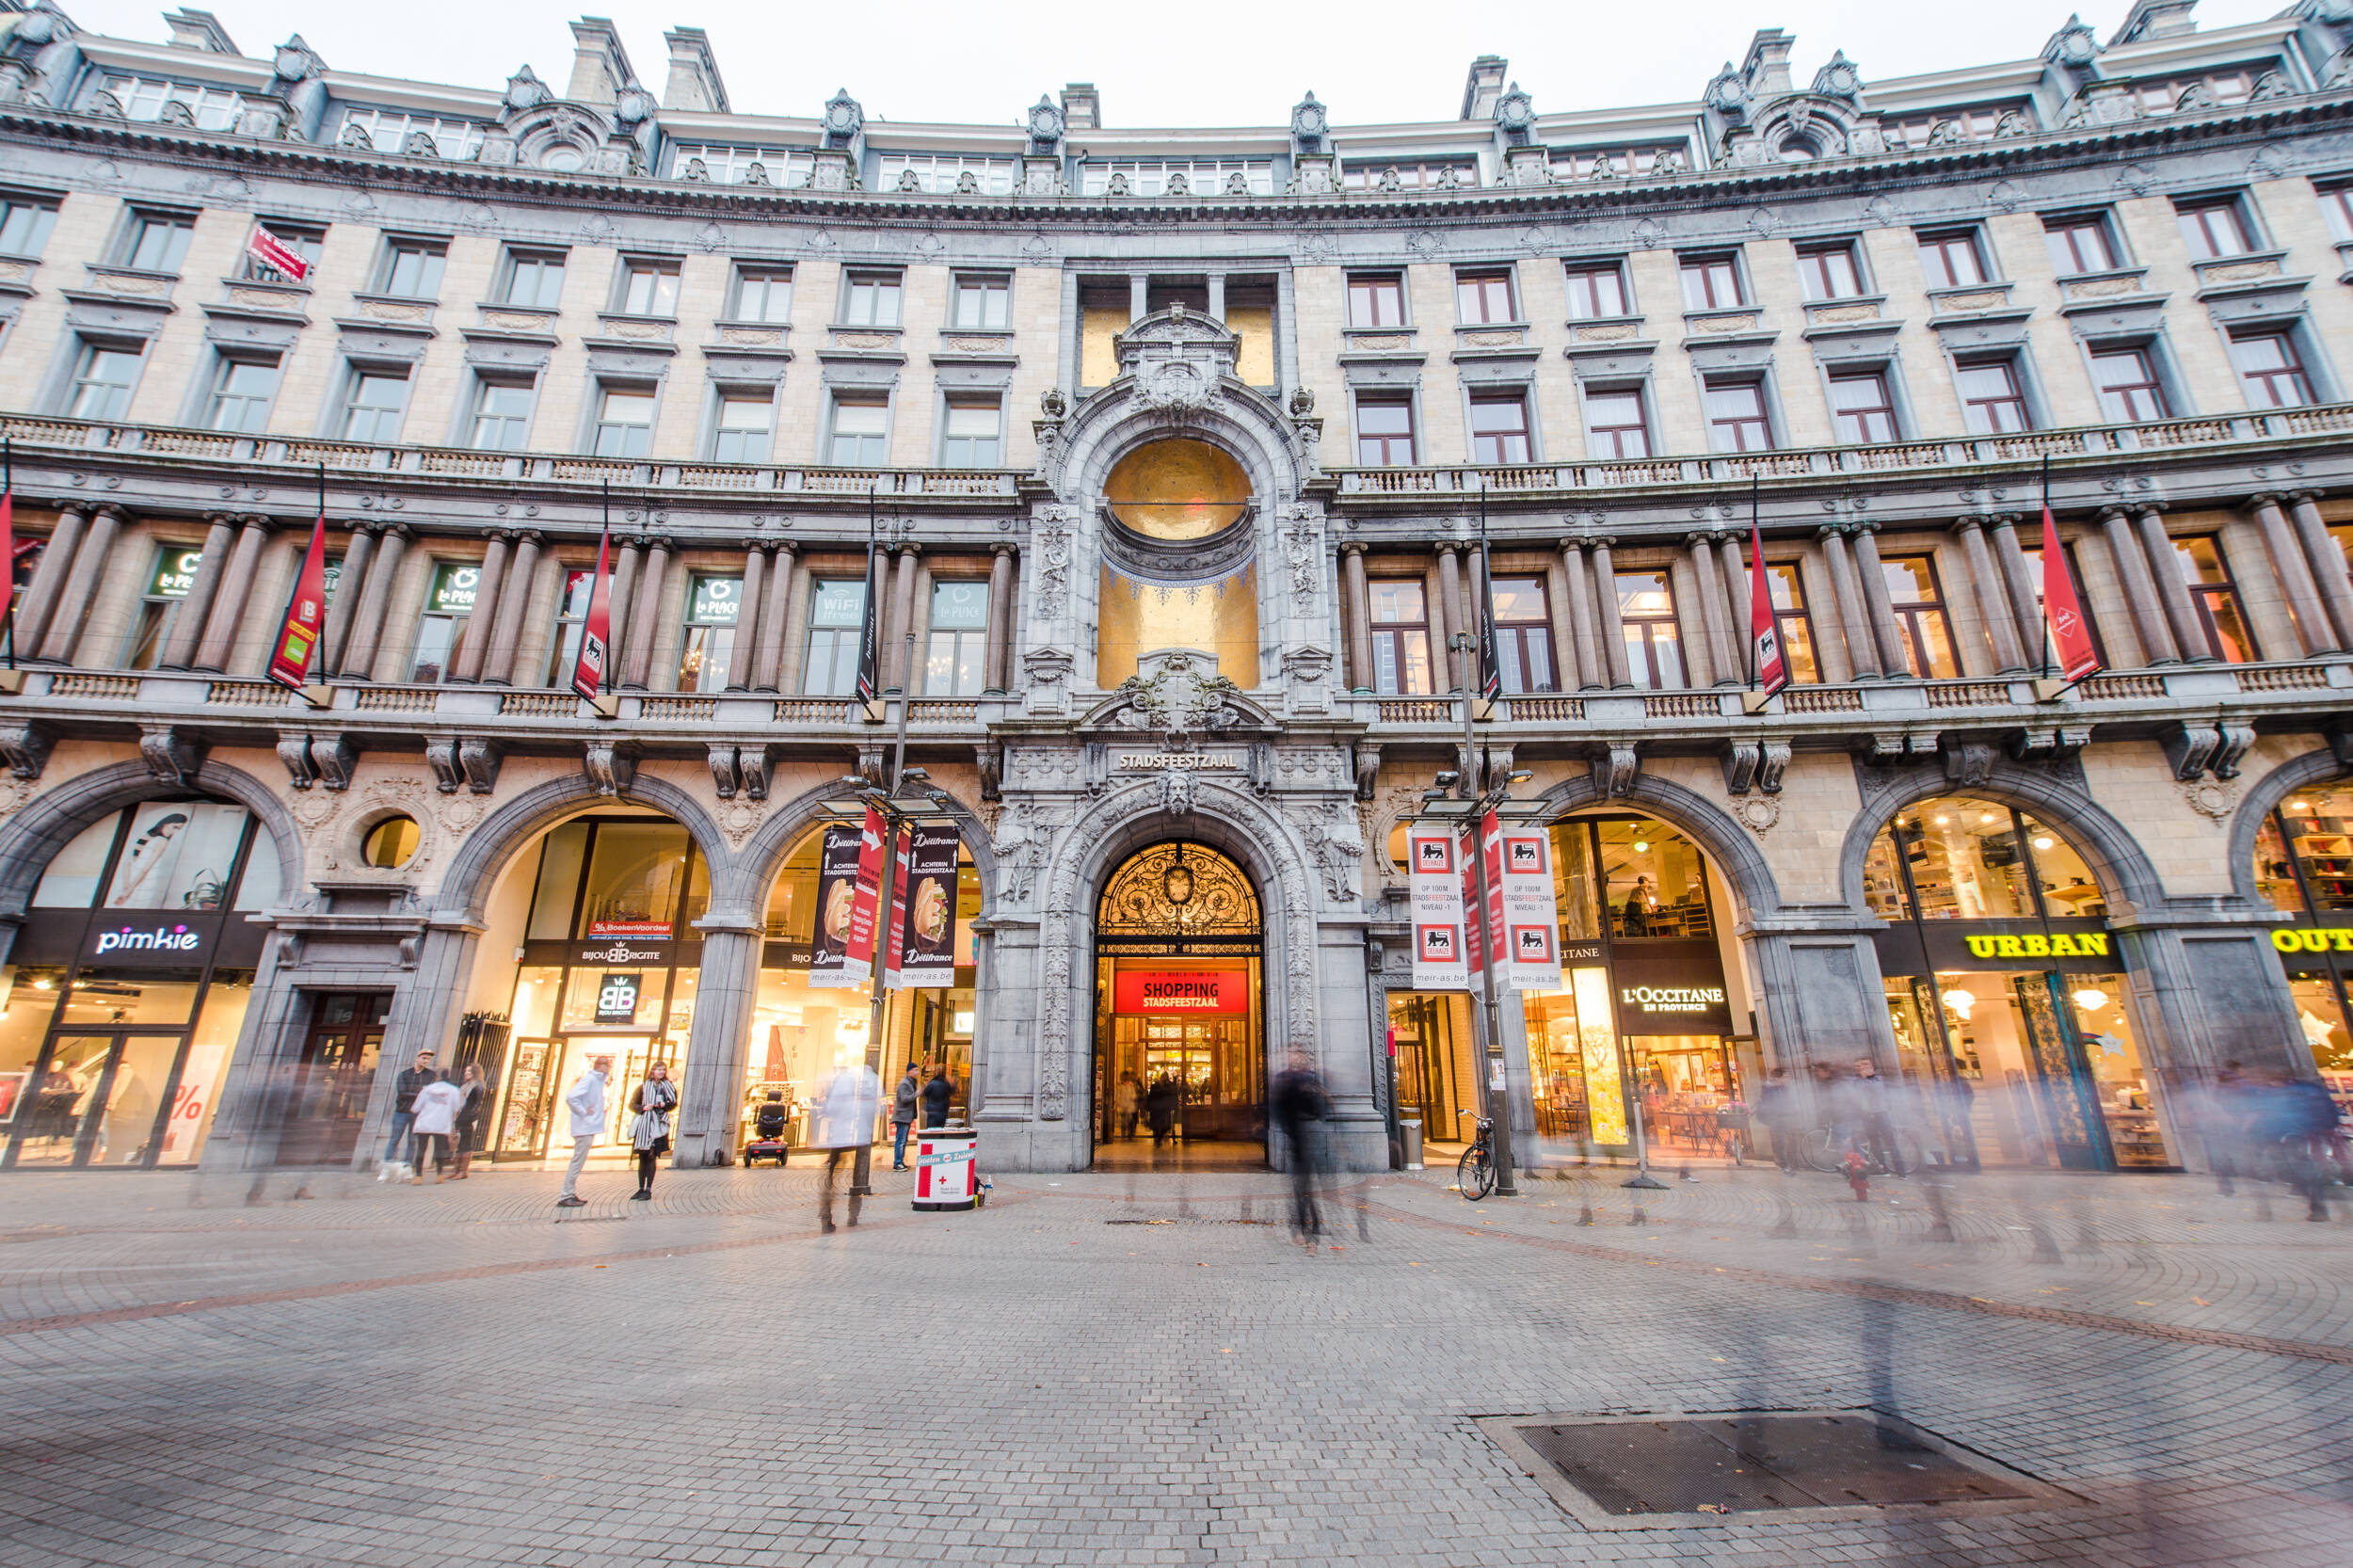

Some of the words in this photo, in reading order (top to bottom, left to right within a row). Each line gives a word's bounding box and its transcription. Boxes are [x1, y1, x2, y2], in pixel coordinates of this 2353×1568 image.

[708, 600, 739, 615] PLACE
[824, 599, 859, 611] WiFi
[1120, 754, 1237, 768] STADSFEESTZAAL
[912, 832, 959, 847] Délifrance
[95, 924, 200, 954] pimkie
[1965, 933, 2109, 958] URBAN
[792, 953, 811, 963] BIJO
[904, 949, 952, 964] Délifrance
[903, 971, 952, 981] meir-as.be
[1416, 973, 1465, 982] meir-as.be
[1144, 983, 1219, 997] SHOPPING
[1623, 986, 1724, 1003] L'OCCITANE
[1143, 998, 1219, 1007] STADSFEESTZAAL
[1643, 1003, 1657, 1012] EN
[1657, 1003, 1706, 1012] PROVENCE
